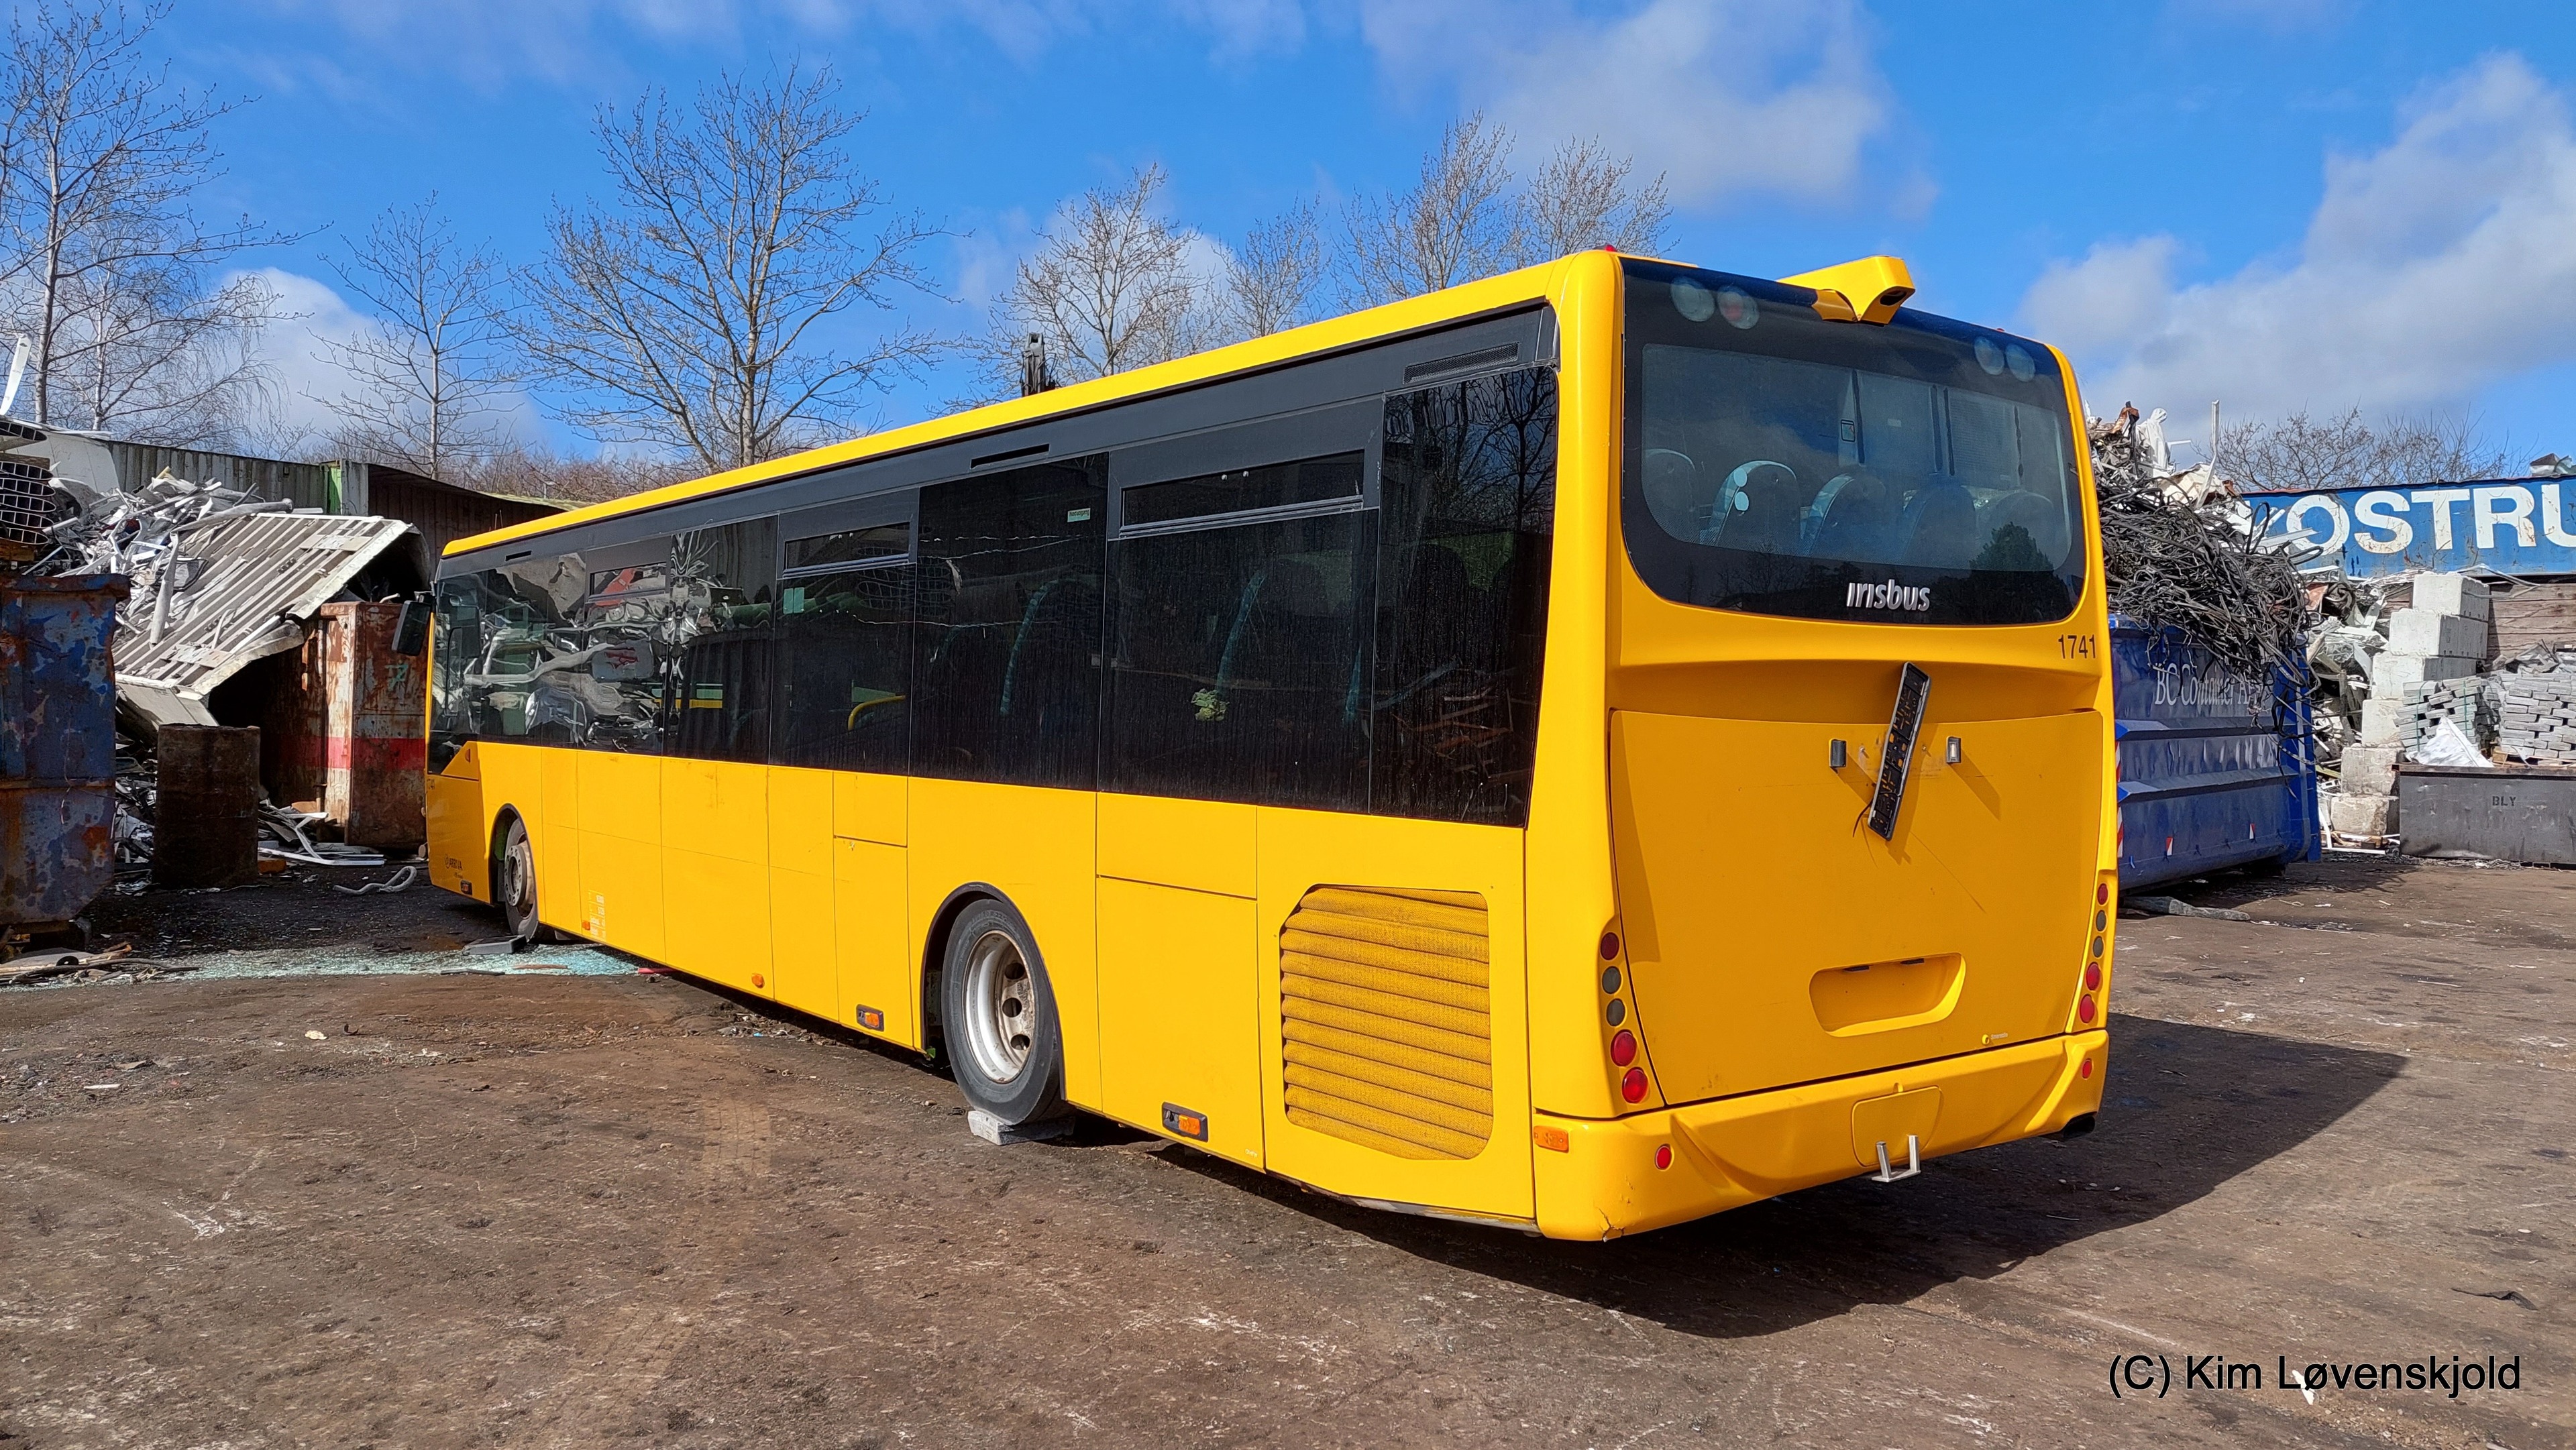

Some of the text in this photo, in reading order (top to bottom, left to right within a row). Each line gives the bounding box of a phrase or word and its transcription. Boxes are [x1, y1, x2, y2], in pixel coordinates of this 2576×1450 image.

[2058, 634, 2096, 659] 1741
[2155, 663, 2178, 706] BC
[2492, 795, 2516, 806] BLY
